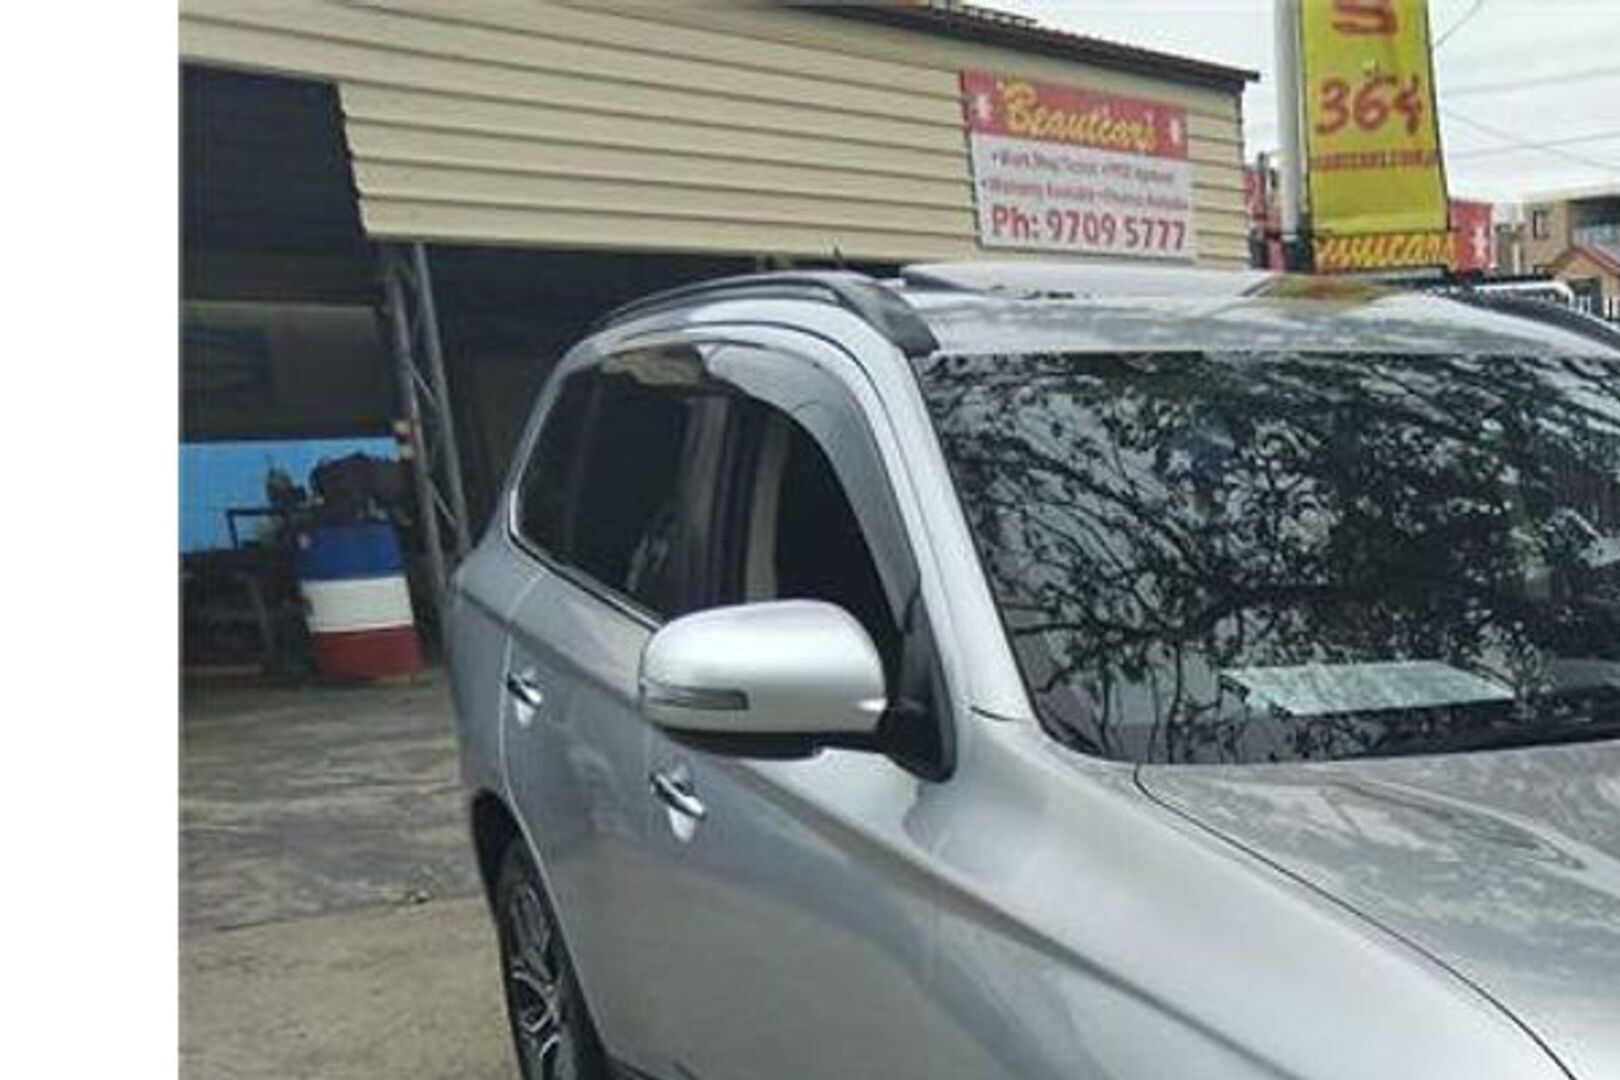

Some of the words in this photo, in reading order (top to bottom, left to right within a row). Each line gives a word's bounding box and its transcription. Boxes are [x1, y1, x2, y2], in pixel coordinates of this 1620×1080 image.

[1314, 73, 1423, 134] 364
[992, 204, 1039, 240] Ph:
[1046, 208, 1117, 247] 9709
[1124, 215, 1186, 250] 5777
